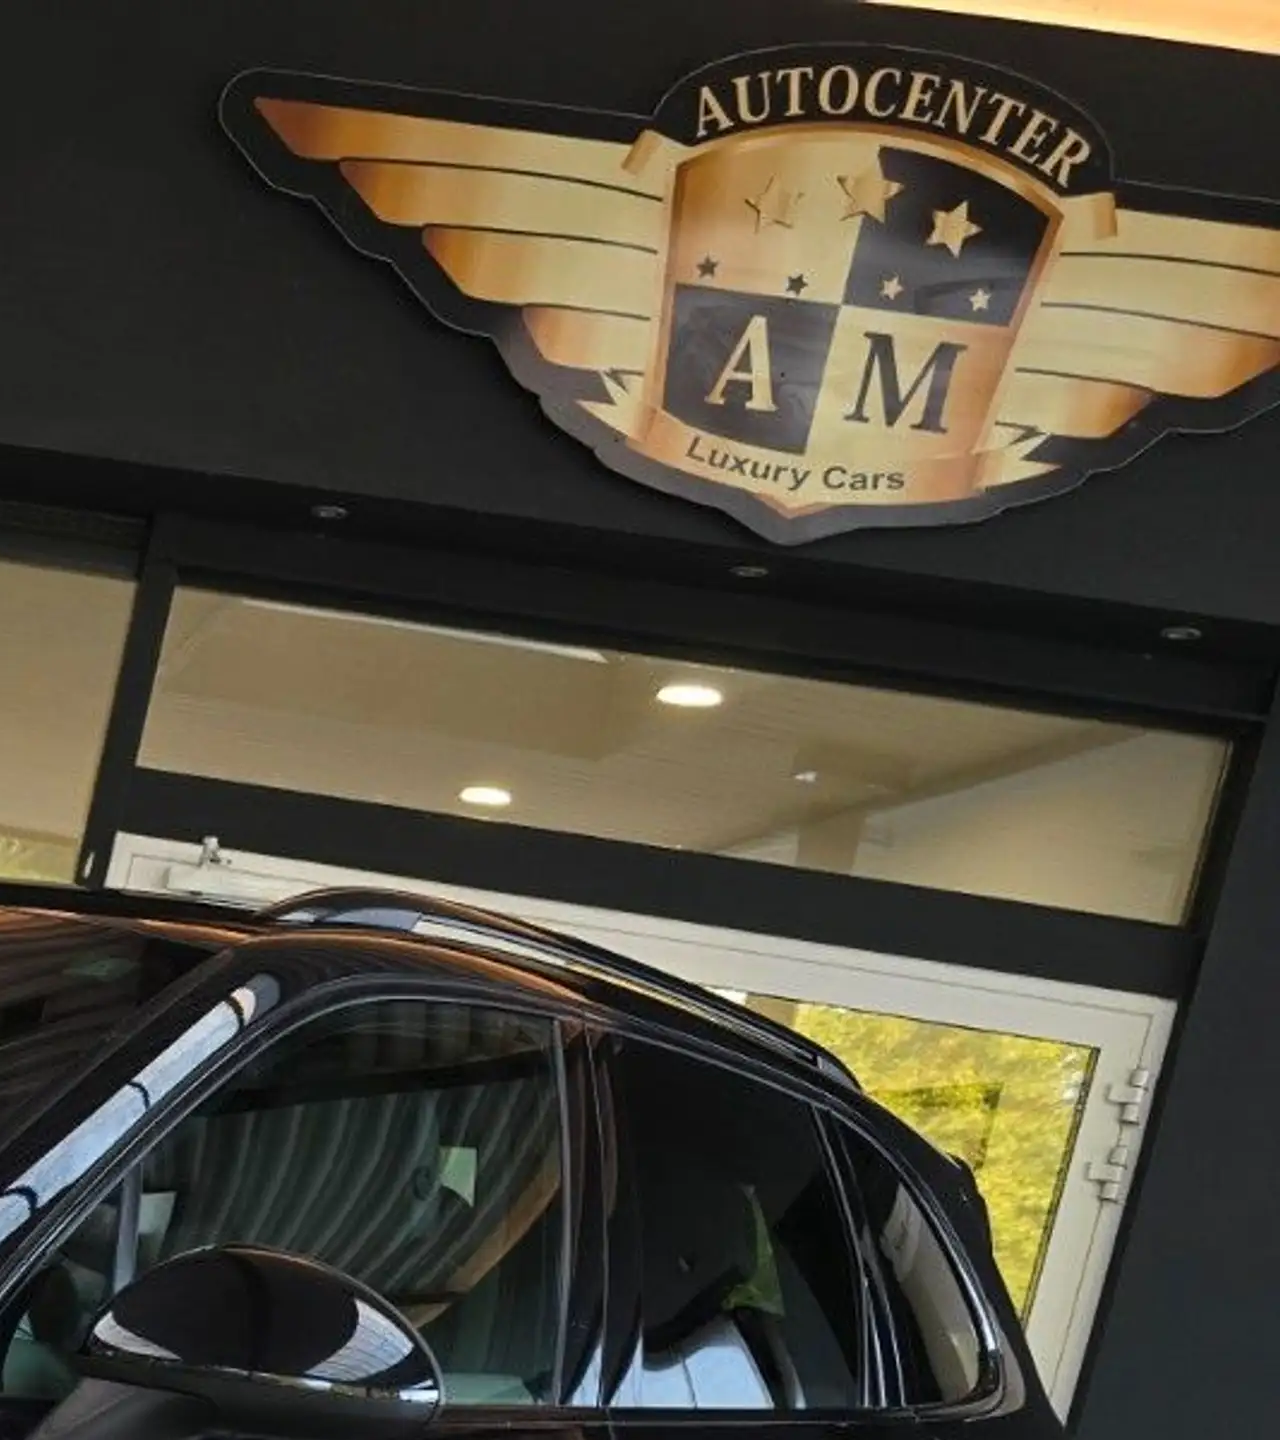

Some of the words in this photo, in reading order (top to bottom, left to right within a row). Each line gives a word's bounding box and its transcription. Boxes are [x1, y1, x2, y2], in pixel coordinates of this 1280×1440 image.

[695, 64, 1093, 188] AUTOCENTER
[704, 314, 780, 412] A
[843, 331, 968, 434] M
[685, 436, 810, 490] Luxury
[822, 465, 906, 491] Cars
